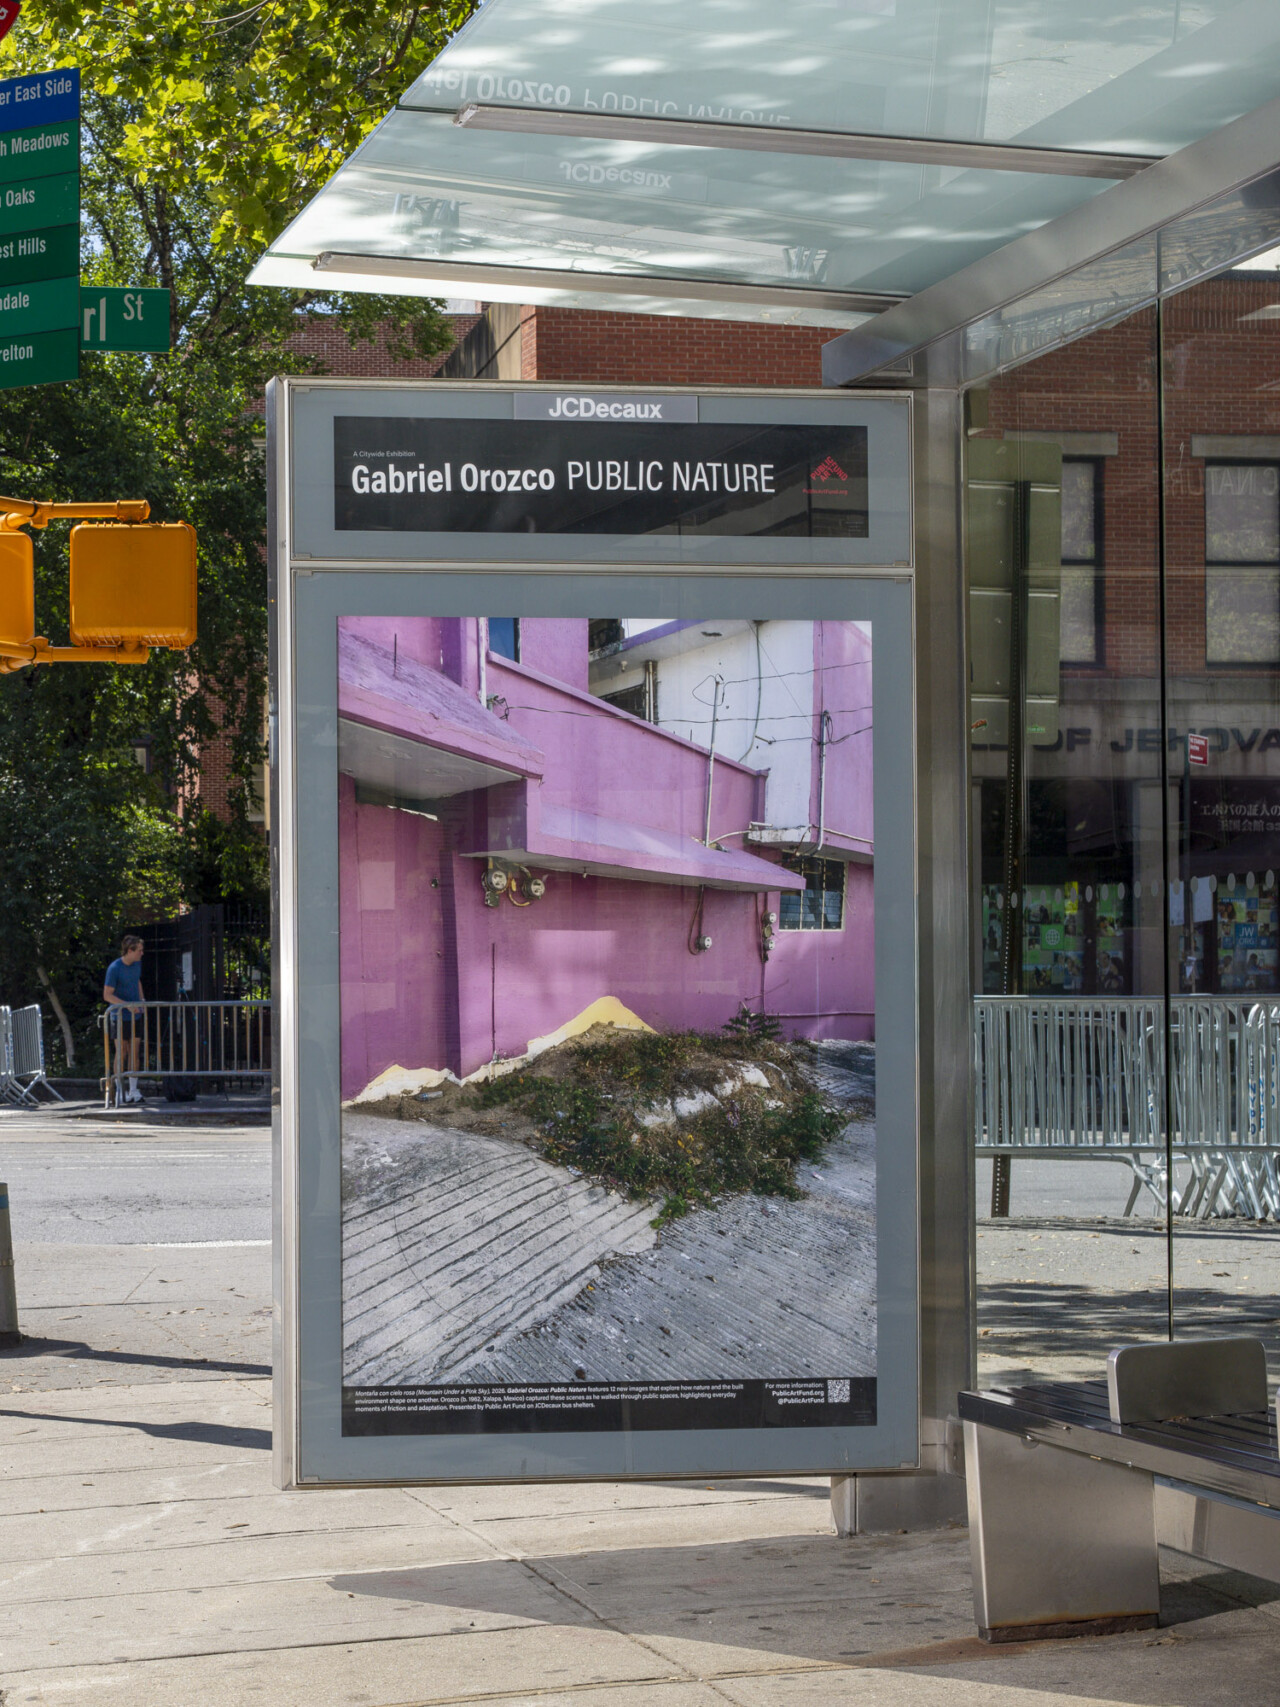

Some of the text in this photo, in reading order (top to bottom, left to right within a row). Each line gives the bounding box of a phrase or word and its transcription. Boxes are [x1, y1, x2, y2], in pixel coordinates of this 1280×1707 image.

[14, 85, 41, 103] East
[45, 78, 73, 97] Side
[11, 131, 70, 155] Meadows
[5, 187, 35, 207] Oaks
[18, 237, 47, 256] Hills
[123, 293, 144, 322] St
[548, 397, 663, 421] JCDecaux
[359, 450, 385, 459] Citywide
[386, 450, 416, 458] Exhibition
[351, 460, 776, 494] Gabriel Orozco PUBLIC NATURE
[810, 456, 833, 481] PUBLIC
[831, 461, 848, 481] FUND
[1239, 927, 1254, 937] JW
[777, 1397, 825, 1405] @PublicArtFund
